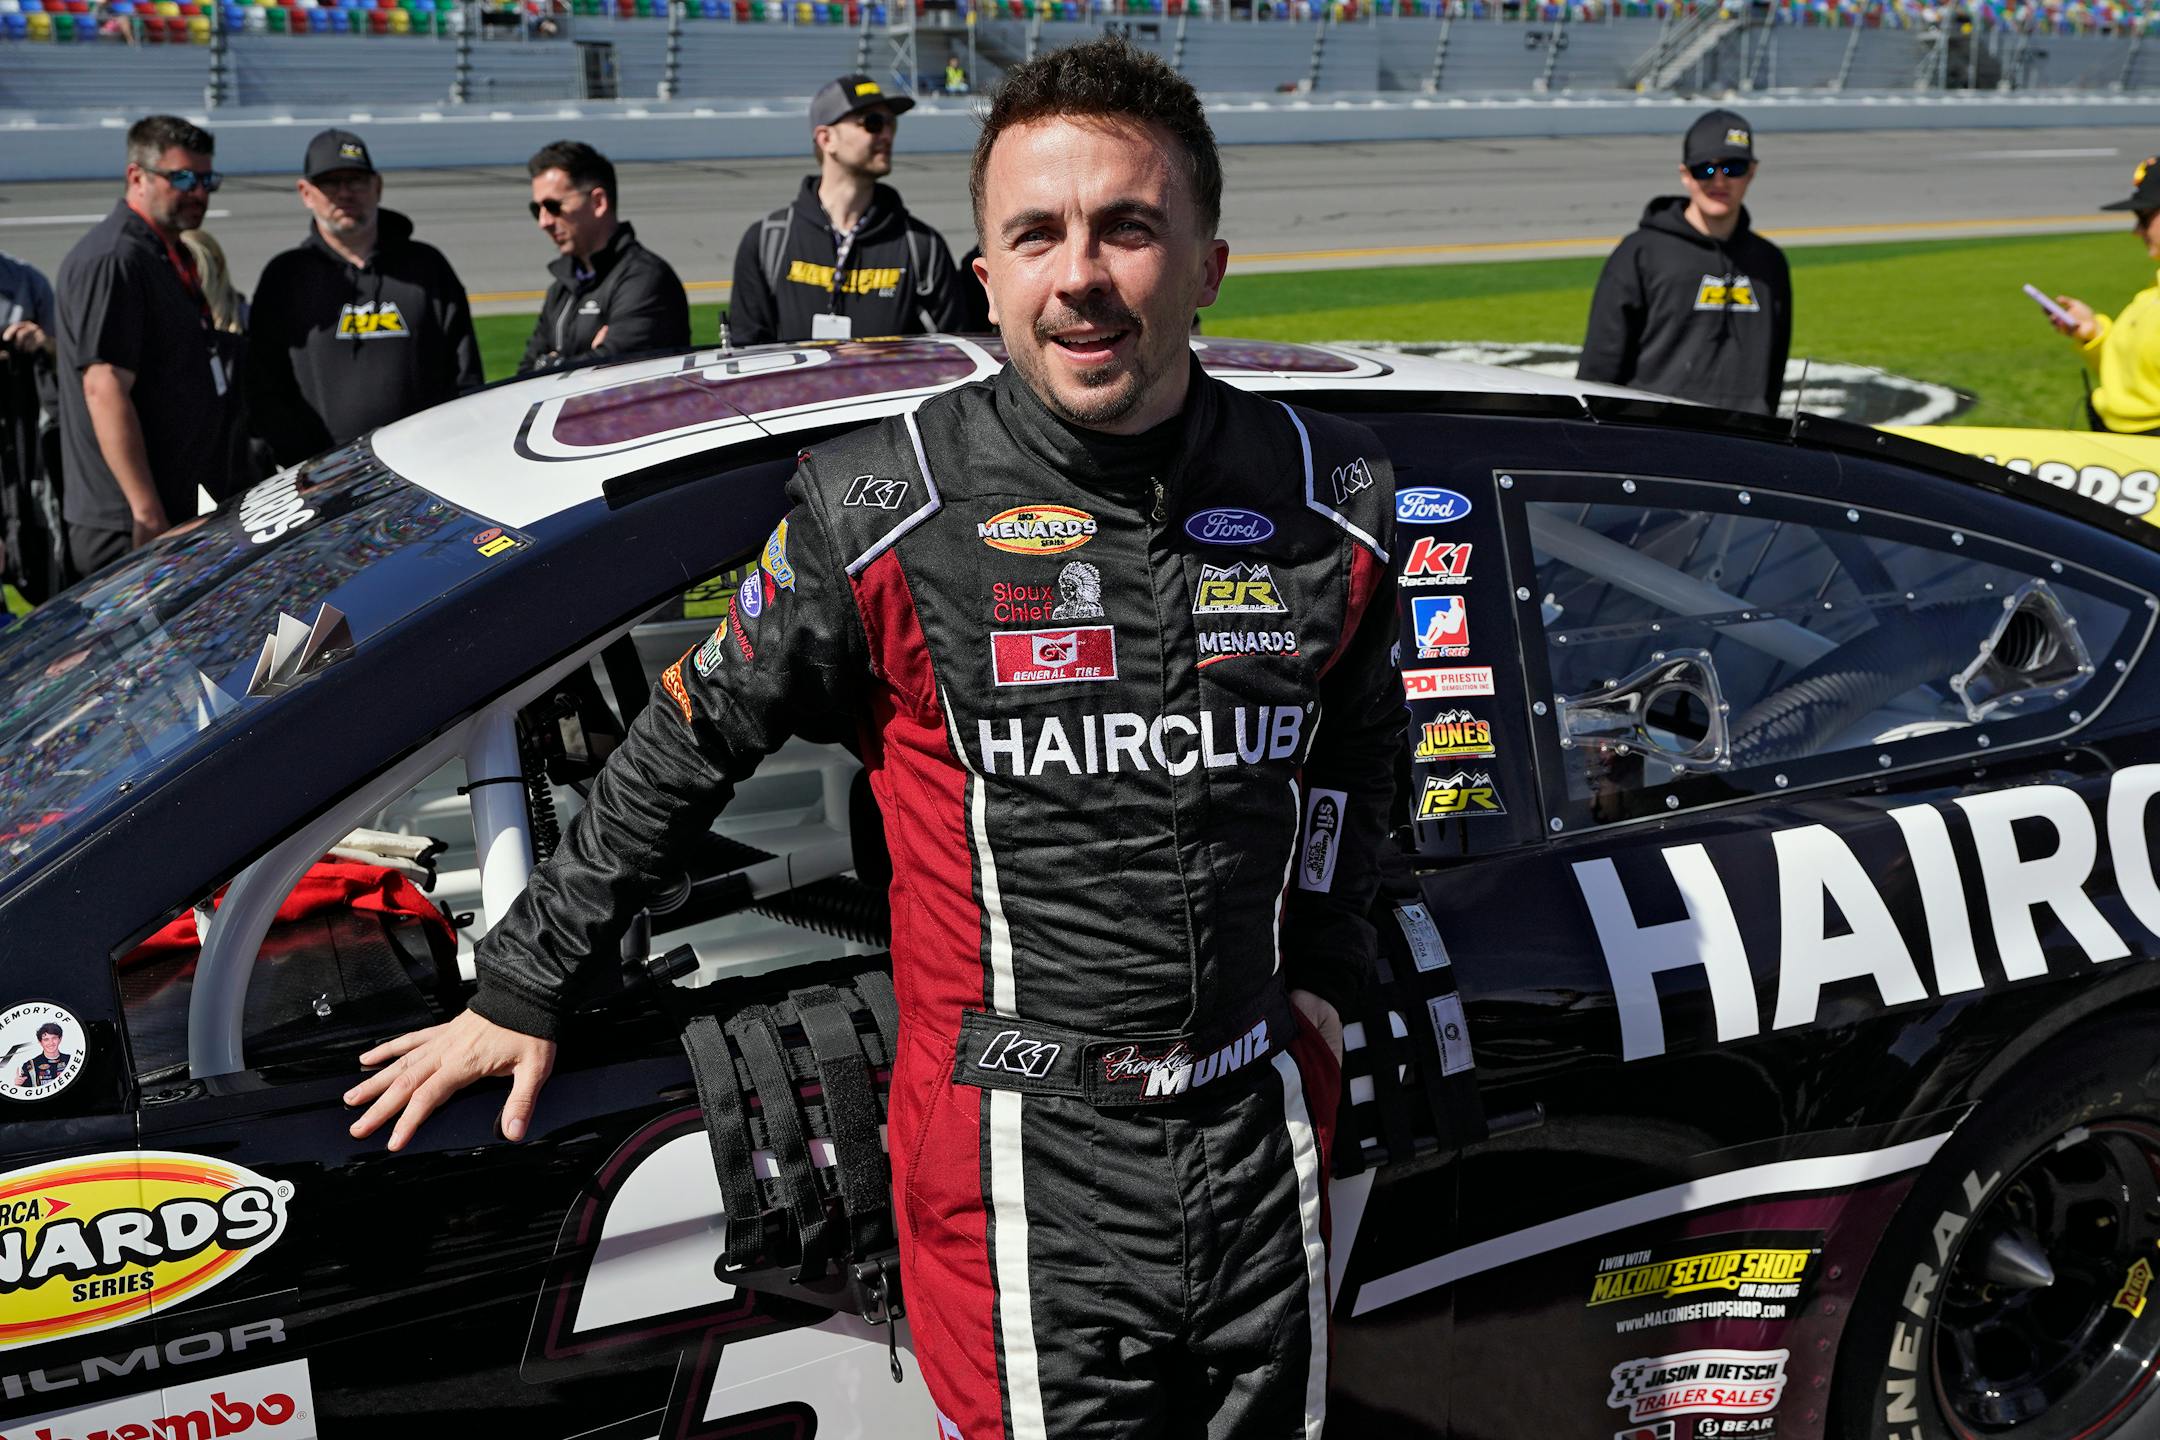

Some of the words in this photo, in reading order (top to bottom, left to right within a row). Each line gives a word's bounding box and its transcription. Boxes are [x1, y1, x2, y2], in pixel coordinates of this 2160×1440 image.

[843, 475, 908, 510] K1
[1332, 457, 1373, 505] K1
[1399, 492, 1455, 518] Ford
[977, 519, 1099, 539] MENARDS
[1203, 512, 1261, 538] Ford
[1404, 536, 1473, 577] K1
[992, 582, 1056, 602] Sioux
[1398, 574, 1472, 587] RaceGear
[993, 602, 1053, 622] Chief
[1199, 631, 1297, 653] MENARDS
[1418, 648, 1440, 659] Sim
[1440, 647, 1470, 658] Seats
[1013, 668, 1067, 681] GENERAL
[1075, 666, 1101, 678] TIRE
[1403, 675, 1437, 693] PDI
[1441, 673, 1488, 684] PRIESTLY
[978, 705, 1304, 777] HAIRCLUB
[1420, 721, 1489, 756] JONES
[1316, 803, 1335, 829] sfi
[1415, 936, 1427, 959] 2024
[55, 1011, 71, 1025] OF
[978, 1030, 1061, 1077] K1
[1106, 1043, 1193, 1076] Frankie
[1145, 1019, 1270, 1096] MUNIZ
[25, 1048, 84, 1097] GUTIÉRREZ
[1605, 1254, 1625, 1269] WIN
[1625, 1250, 1652, 1268] WITH
[72, 1271, 154, 1303] SERIES
[1591, 1264, 1672, 1301] MACONI
[1671, 1254, 1741, 1287] SETUP
[1741, 1253, 1808, 1279] SHOP
[2126, 1268, 2147, 1307] AERO
[1738, 1284, 1756, 1297] ON
[2, 1318, 286, 1399] ILMOR
[1645, 1364, 1699, 1388] JASON
[1705, 1363, 1778, 1380] DIETSCH
[1635, 1388, 1707, 1413] TRAILER
[1711, 1388, 1776, 1406] SALES
[35, 1392, 296, 1440] embo
[1722, 1417, 1774, 1432] BEAR
